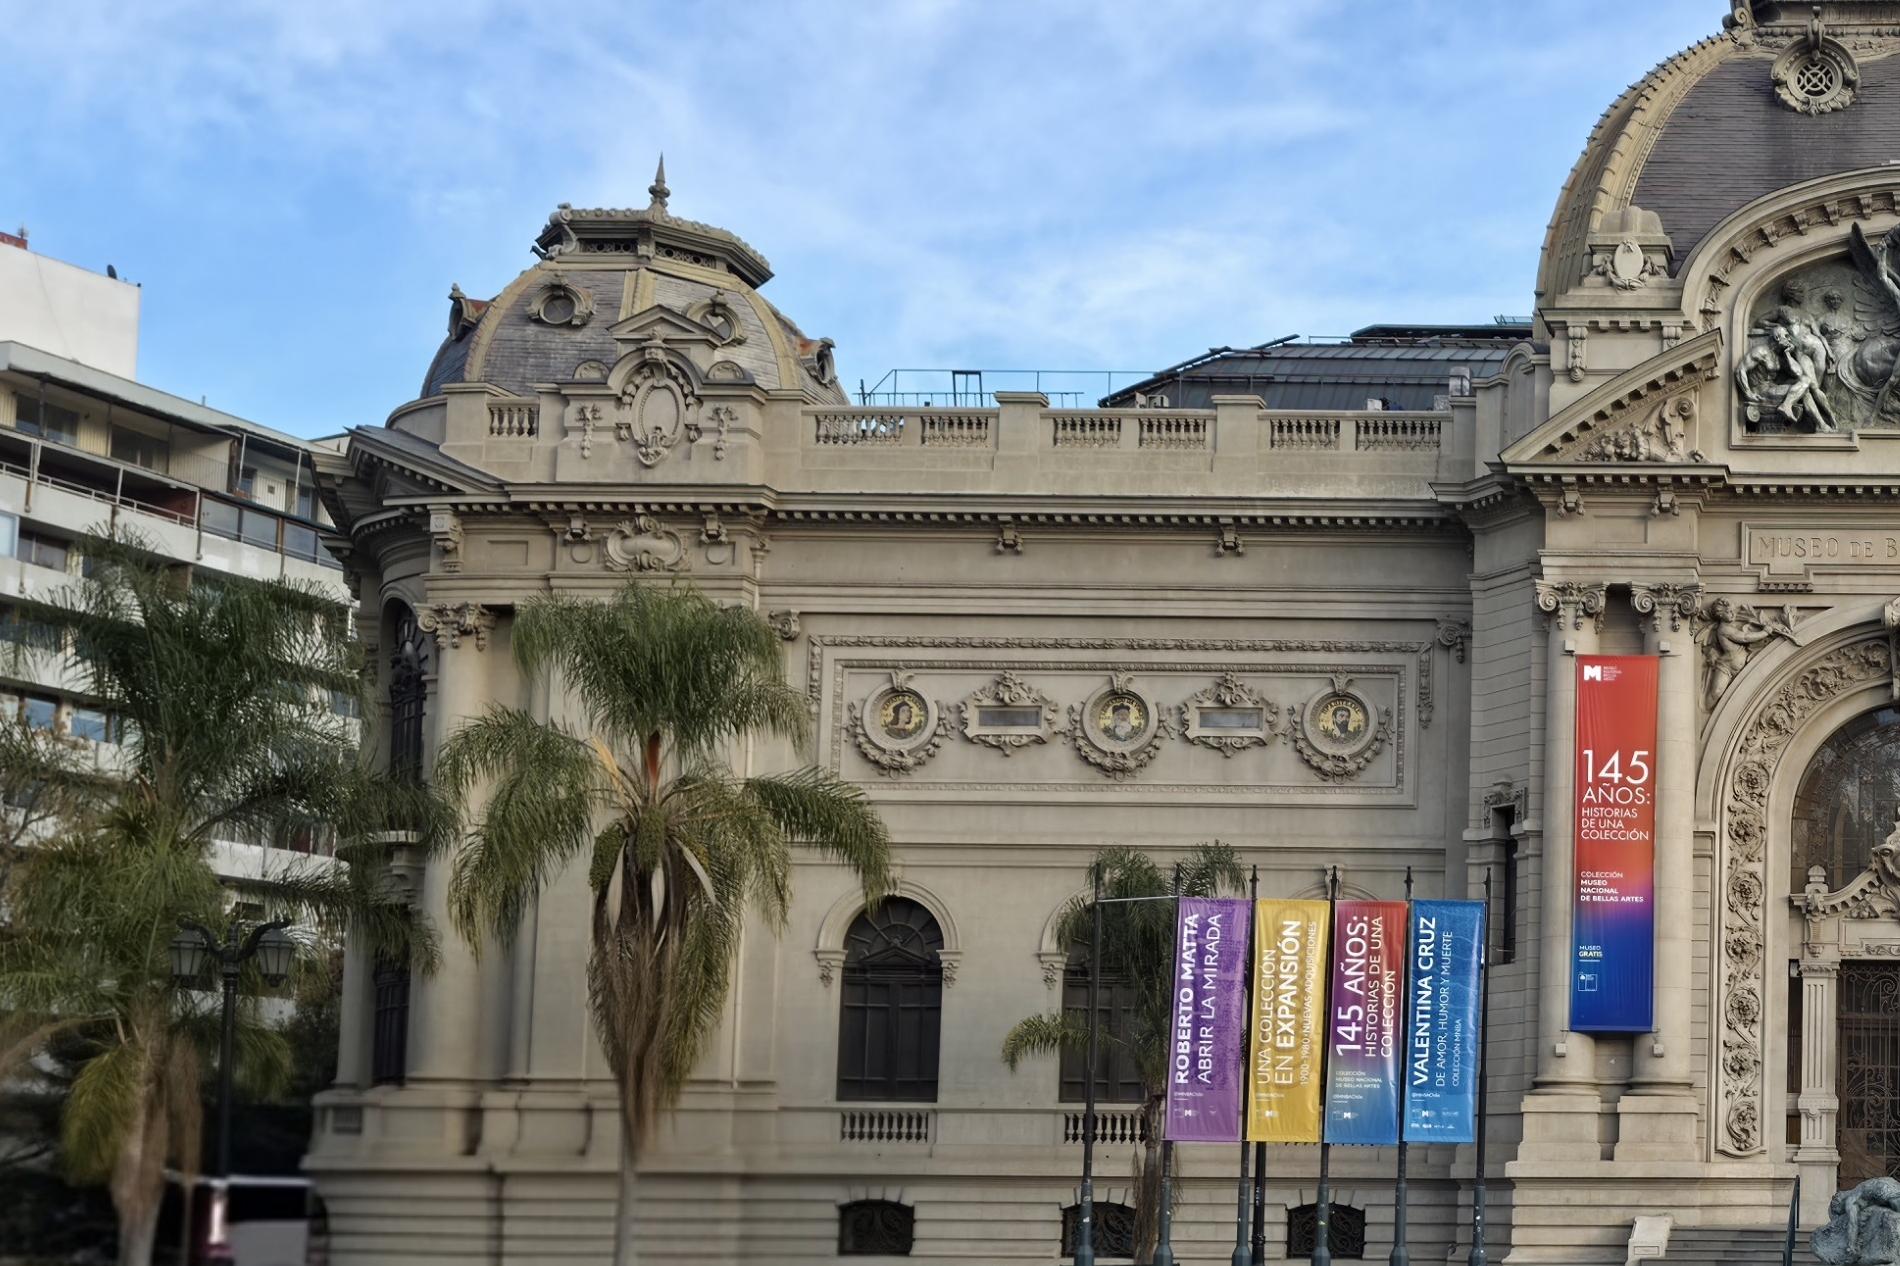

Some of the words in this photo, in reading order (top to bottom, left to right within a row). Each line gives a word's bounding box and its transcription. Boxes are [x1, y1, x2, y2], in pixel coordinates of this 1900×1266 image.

[1758, 537, 1839, 558] MUSEO
[1849, 541, 1874, 558] DE
[1583, 665, 1602, 681] M
[1583, 749, 1649, 784] 145
[1581, 807, 1638, 818] HISTORIAS
[1582, 782, 1651, 805] AÑOS:
[1581, 818, 1596, 828] DE
[1599, 819, 1625, 829] UNA
[1581, 828, 1649, 840] COLECCIÓN
[1181, 914, 1199, 980] MATTA
[1203, 914, 1222, 989] MIRADA
[1370, 916, 1383, 950] UNA
[1418, 916, 1436, 971] CRUZ
[1304, 921, 1317, 994] ADQUISICIONES
[1340, 916, 1369, 996] AÑOS:
[1369, 955, 1381, 975] DE
[1441, 930, 1453, 976] MUERTE
[1259, 949, 1277, 1043] COLECCIÓN
[1276, 920, 1302, 1048] EXPANSIÓN
[1440, 976, 1450, 985] Y
[1201, 996, 1216, 1019] LA
[1365, 981, 1380, 1057] HISTORIAS
[1380, 970, 1396, 1058] COLECCIÓN
[1438, 986, 1450, 1030] HUMOR
[1175, 987, 1194, 1084] ROBERTO
[1336, 1005, 1363, 1056] 145
[1413, 975, 1433, 1086] VALENTINA
[1454, 1018, 1462, 1041] MNBA
[1197, 1026, 1214, 1085] ABRIR
[1257, 1047, 1271, 1084] UNA
[1274, 1055, 1293, 1084] EN
[1436, 1032, 1448, 1070] AMOR,
[1435, 1072, 1446, 1087] DE
